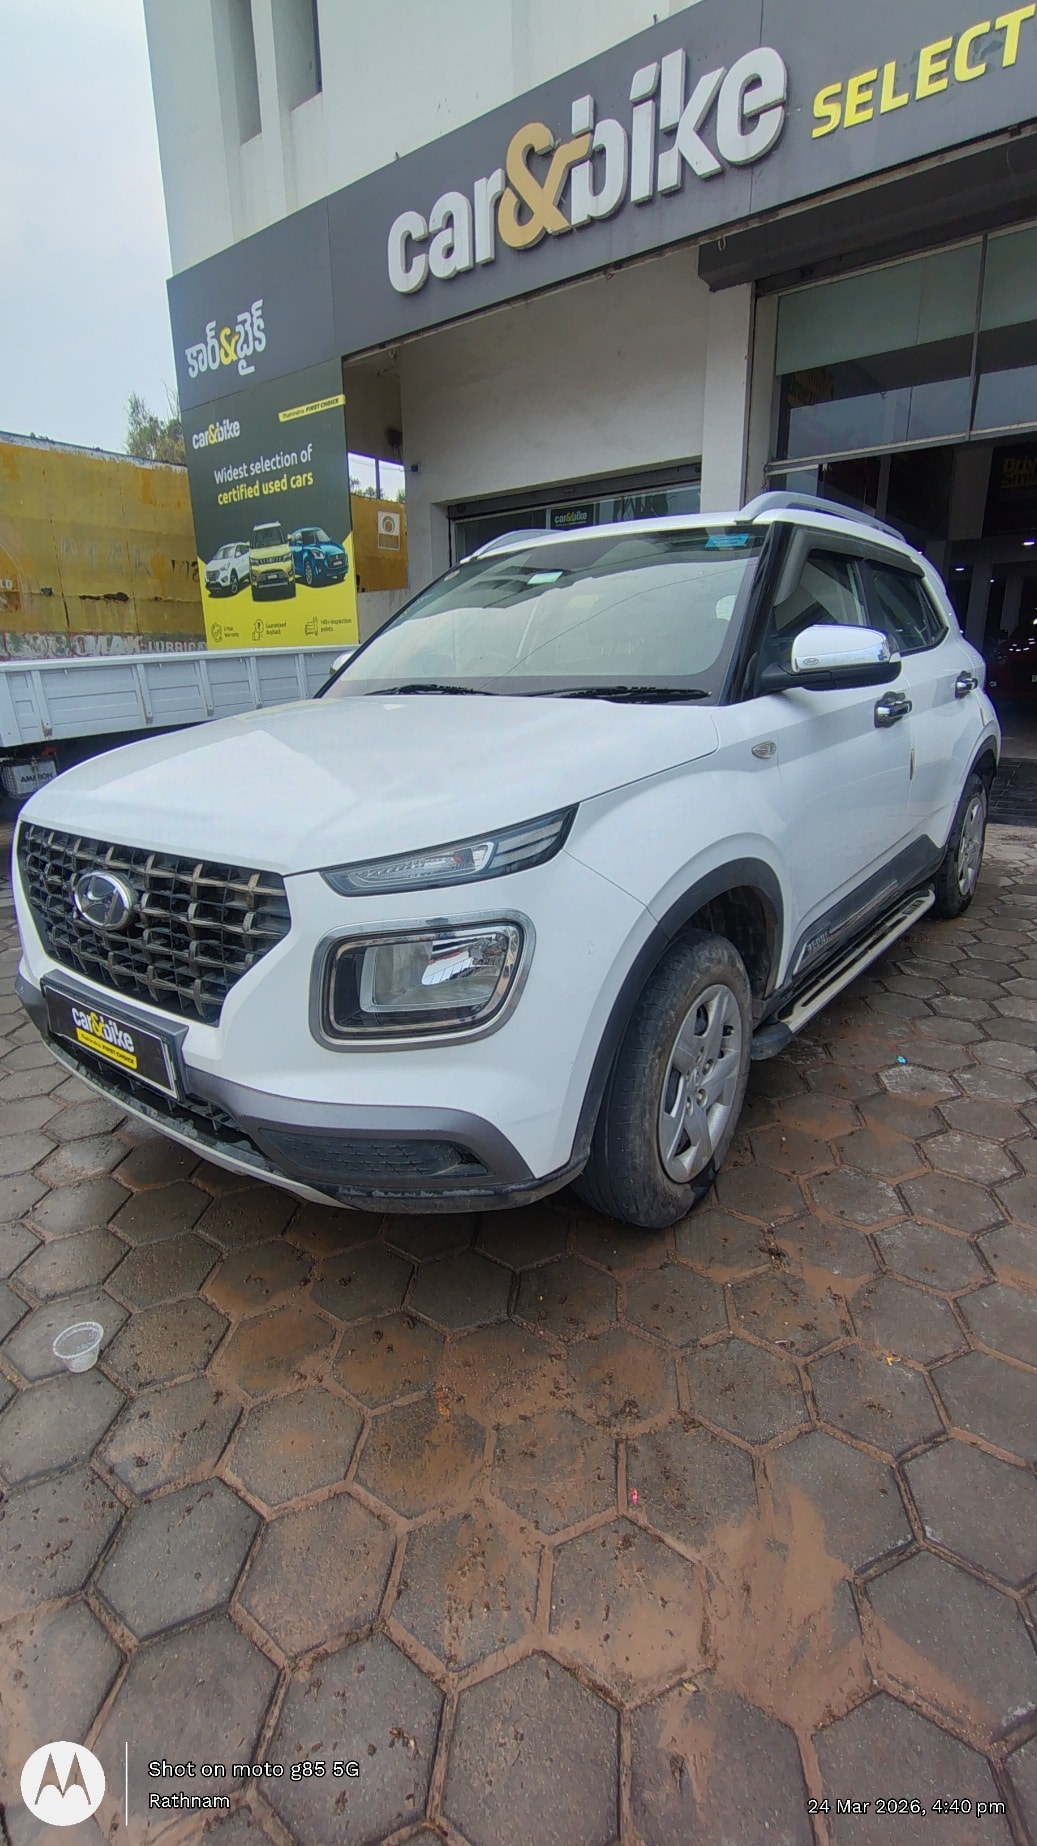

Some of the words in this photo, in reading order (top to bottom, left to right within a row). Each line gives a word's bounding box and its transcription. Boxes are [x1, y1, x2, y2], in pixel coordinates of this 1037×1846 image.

[386, 47, 789, 295] car&bike
[811, 3, 1037, 139] SELECT
[306, 402, 320, 413] FIRST
[192, 418, 241, 450] car&bike
[213, 464, 249, 485] Widest
[249, 450, 298, 476] selection
[300, 443, 313, 463] of
[217, 482, 260, 505] certified
[262, 474, 288, 497] used
[290, 472, 314, 489] cars
[554, 510, 588, 524] car&bike
[71, 1007, 135, 1053] car&bike
